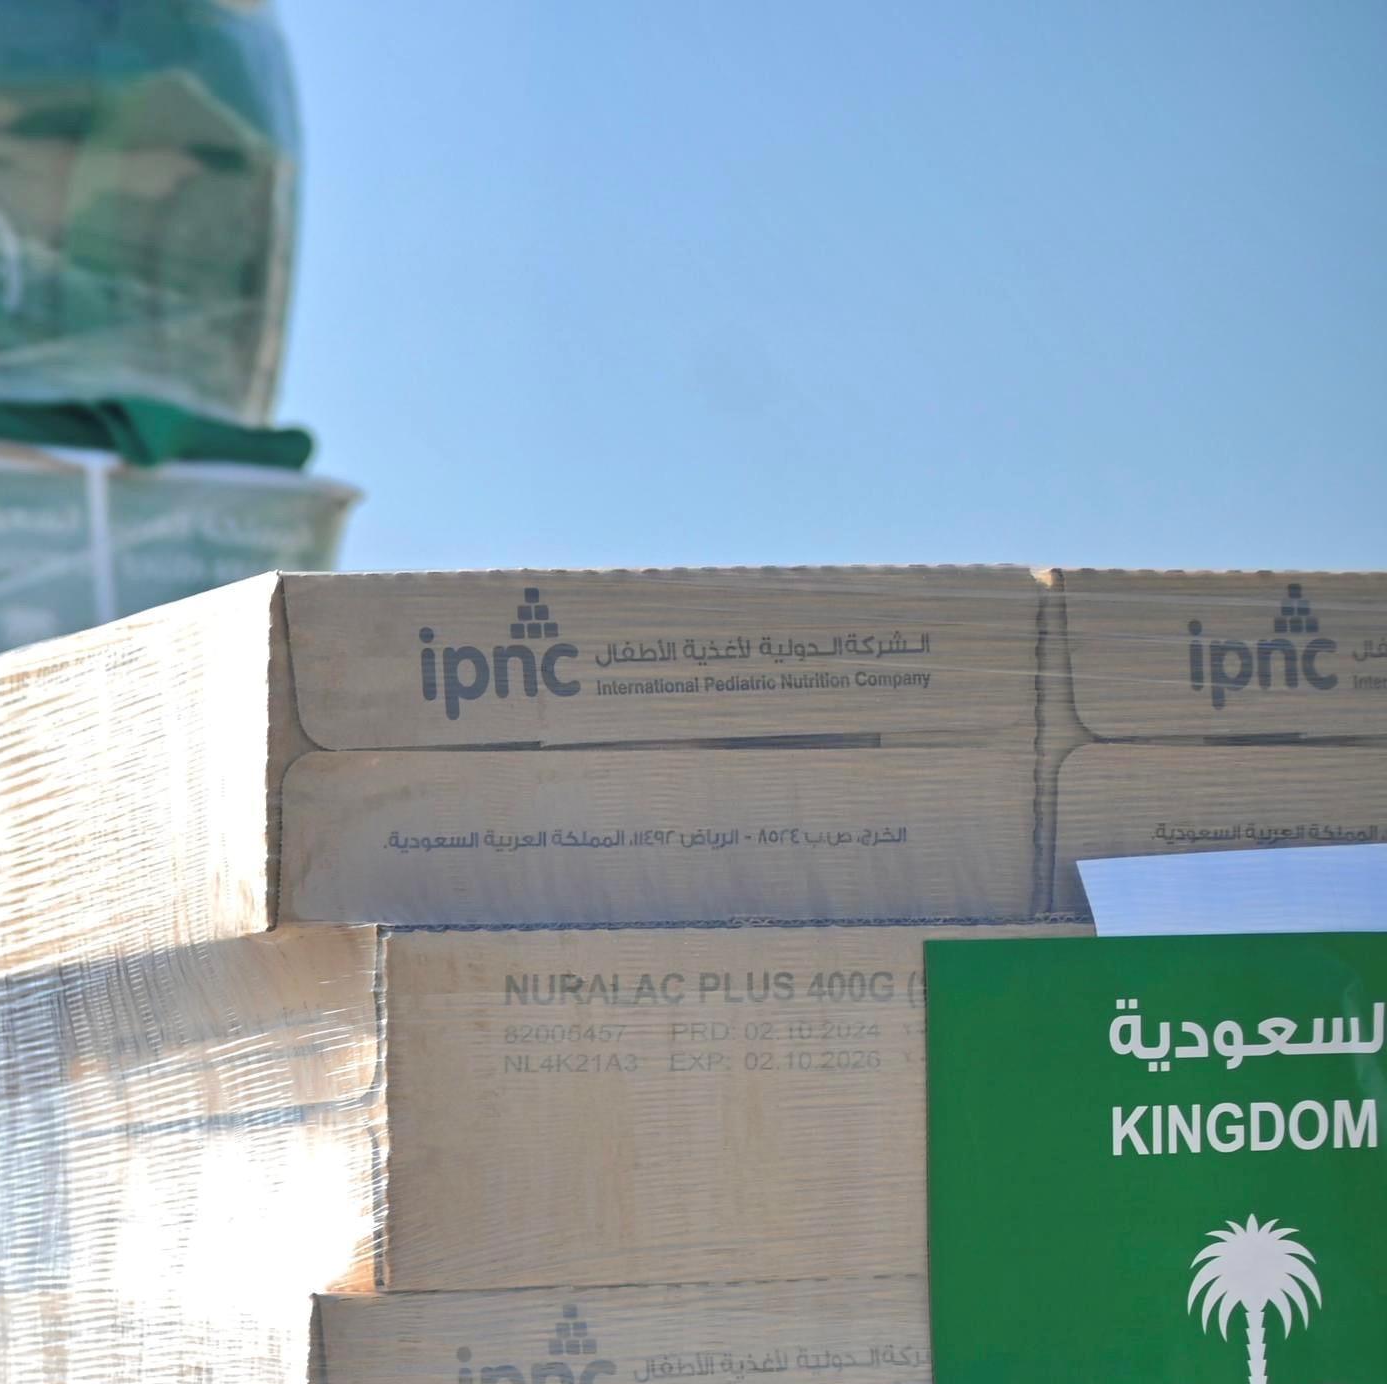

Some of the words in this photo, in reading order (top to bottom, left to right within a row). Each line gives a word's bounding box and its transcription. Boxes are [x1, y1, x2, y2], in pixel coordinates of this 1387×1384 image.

[595, 640, 676, 668] الأطفال
[1188, 619, 1339, 711] ipnc
[418, 626, 581, 721] ipnc
[596, 678, 699, 696] International
[704, 674, 777, 692] Pediatric
[781, 671, 850, 689] Nutrition
[855, 669, 931, 693] Company
[483, 829, 547, 851] العربية
[551, 828, 626, 848] المملكة
[504, 972, 685, 1006] NURALAC
[699, 971, 795, 1002] PLUS
[807, 970, 894, 999] 400G
[1109, 999, 1387, 1072] لسعودية
[1112, 1099, 1378, 1157] KINGDOM
